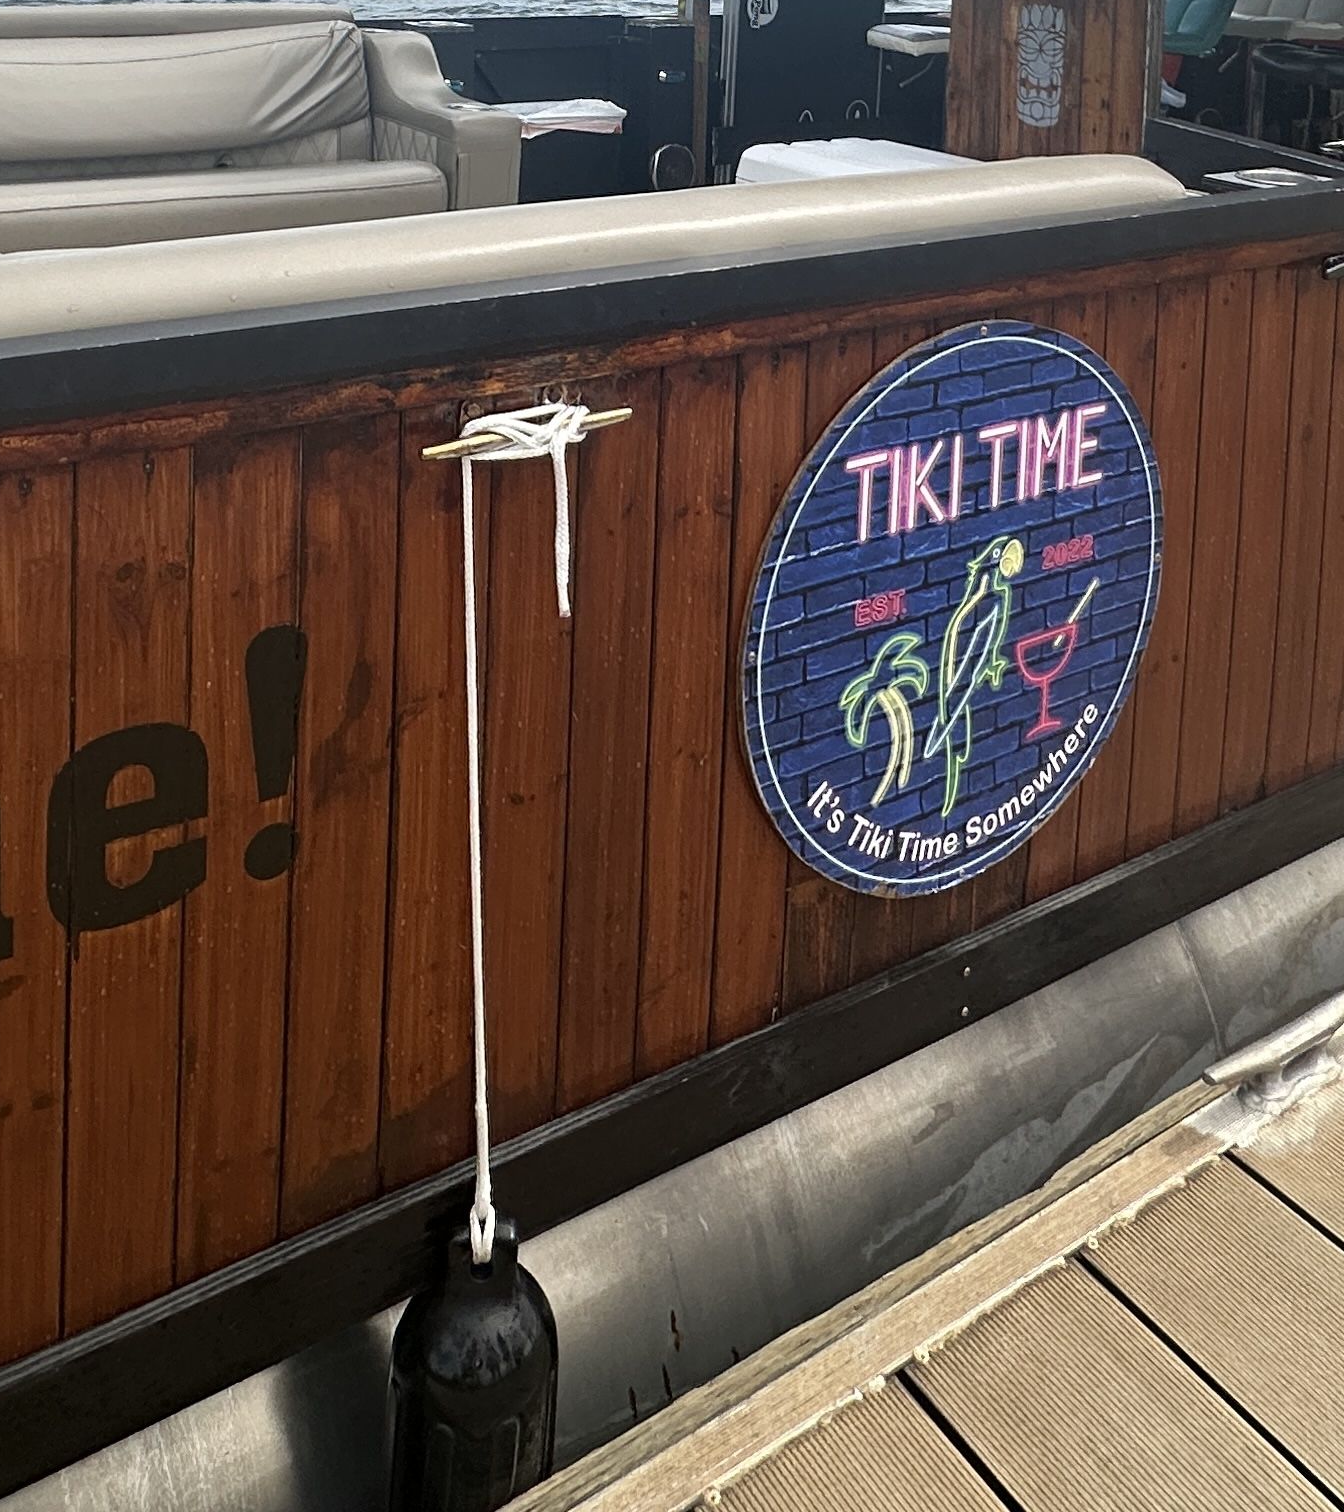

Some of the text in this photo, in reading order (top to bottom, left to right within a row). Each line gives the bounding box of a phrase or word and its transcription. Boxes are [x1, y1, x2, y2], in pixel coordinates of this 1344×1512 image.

[845, 403, 1107, 543] TIKI TIME
[1041, 534, 1094, 570] 2022
[855, 589, 907, 627] EST.
[807, 703, 1099, 862] It's Tiki Time Somewhere
